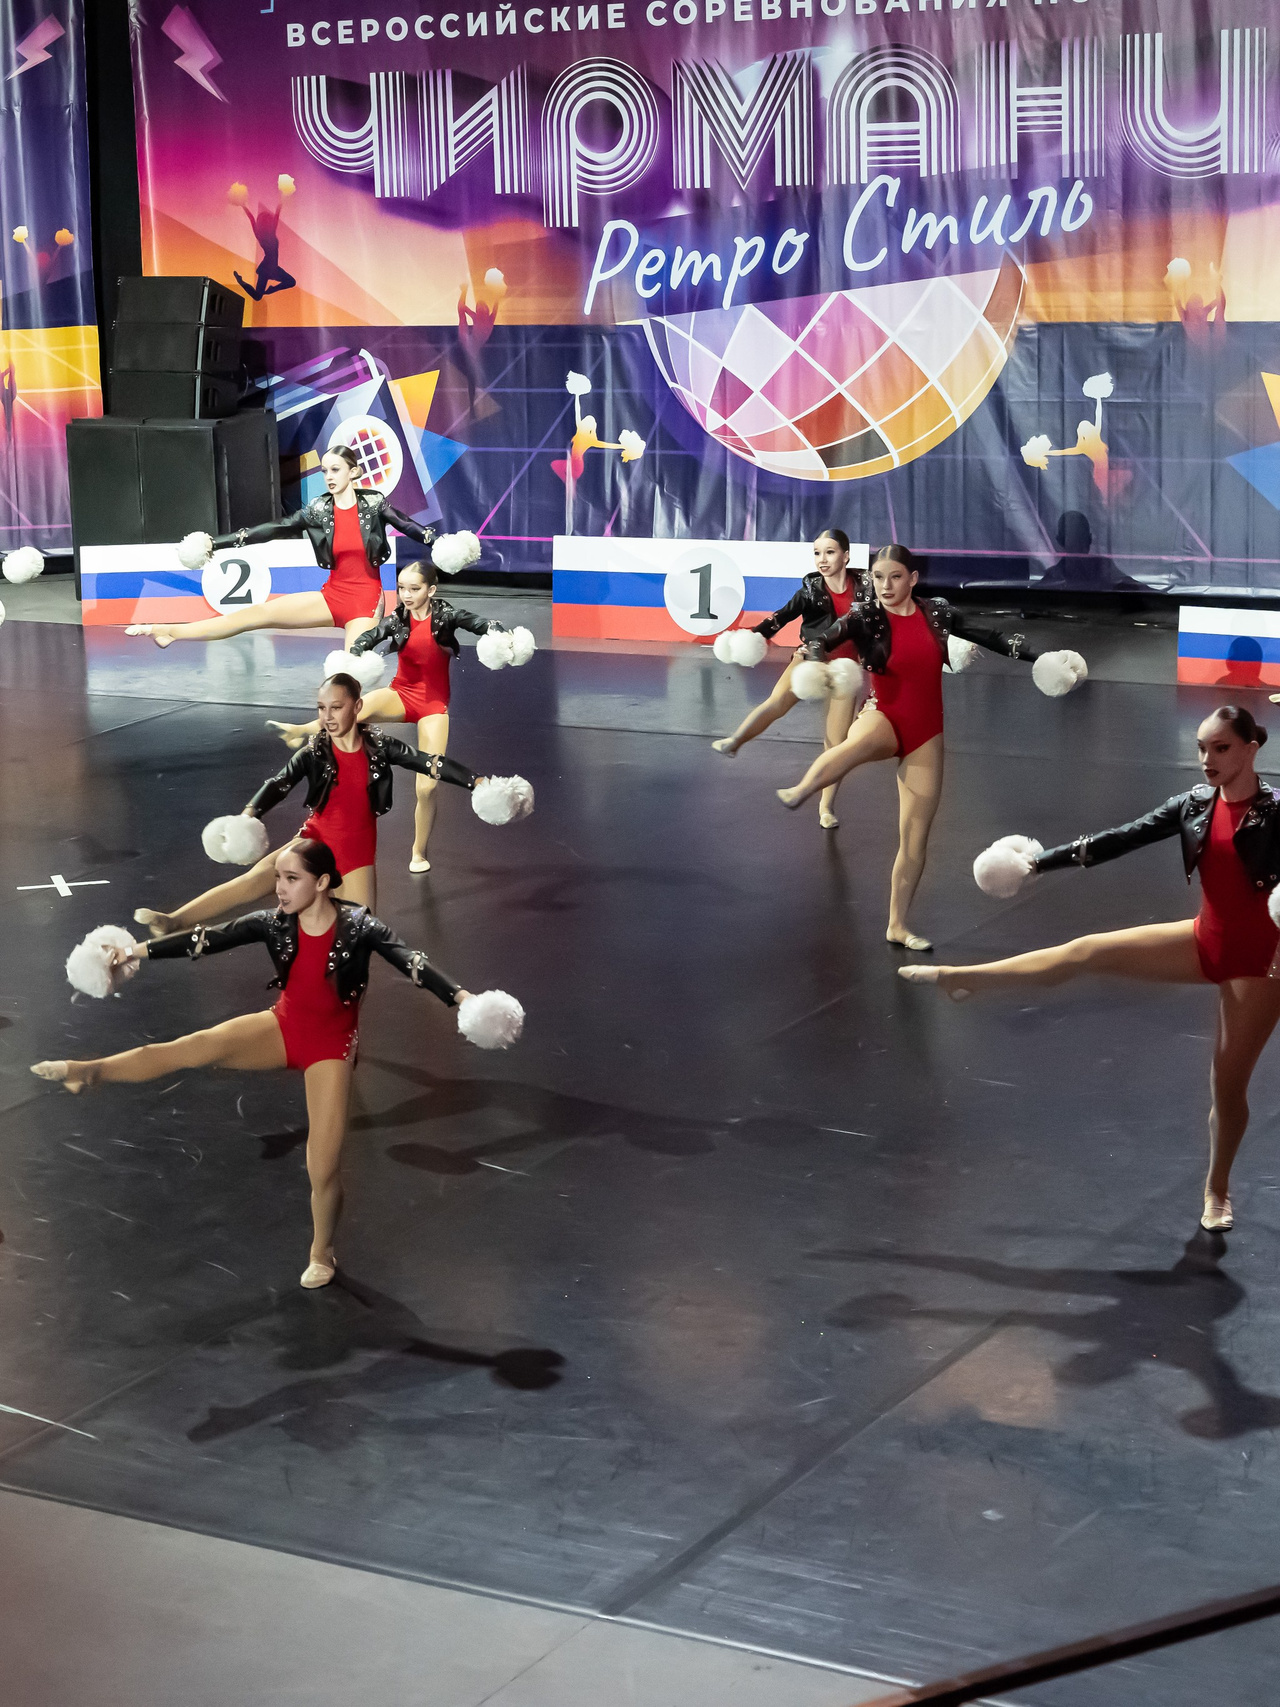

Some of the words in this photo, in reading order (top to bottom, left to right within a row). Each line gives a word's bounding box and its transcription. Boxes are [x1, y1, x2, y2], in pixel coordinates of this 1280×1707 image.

[287, 3, 626, 47] ВСЕРОССИЙСКИЕ
[646, 0, 1007, 26] СОРЕВНОВА
[584, 219, 809, 315] Ретро
[843, 175, 1094, 272] Стиль
[220, 559, 252, 604] 2
[690, 563, 718, 619] 1
